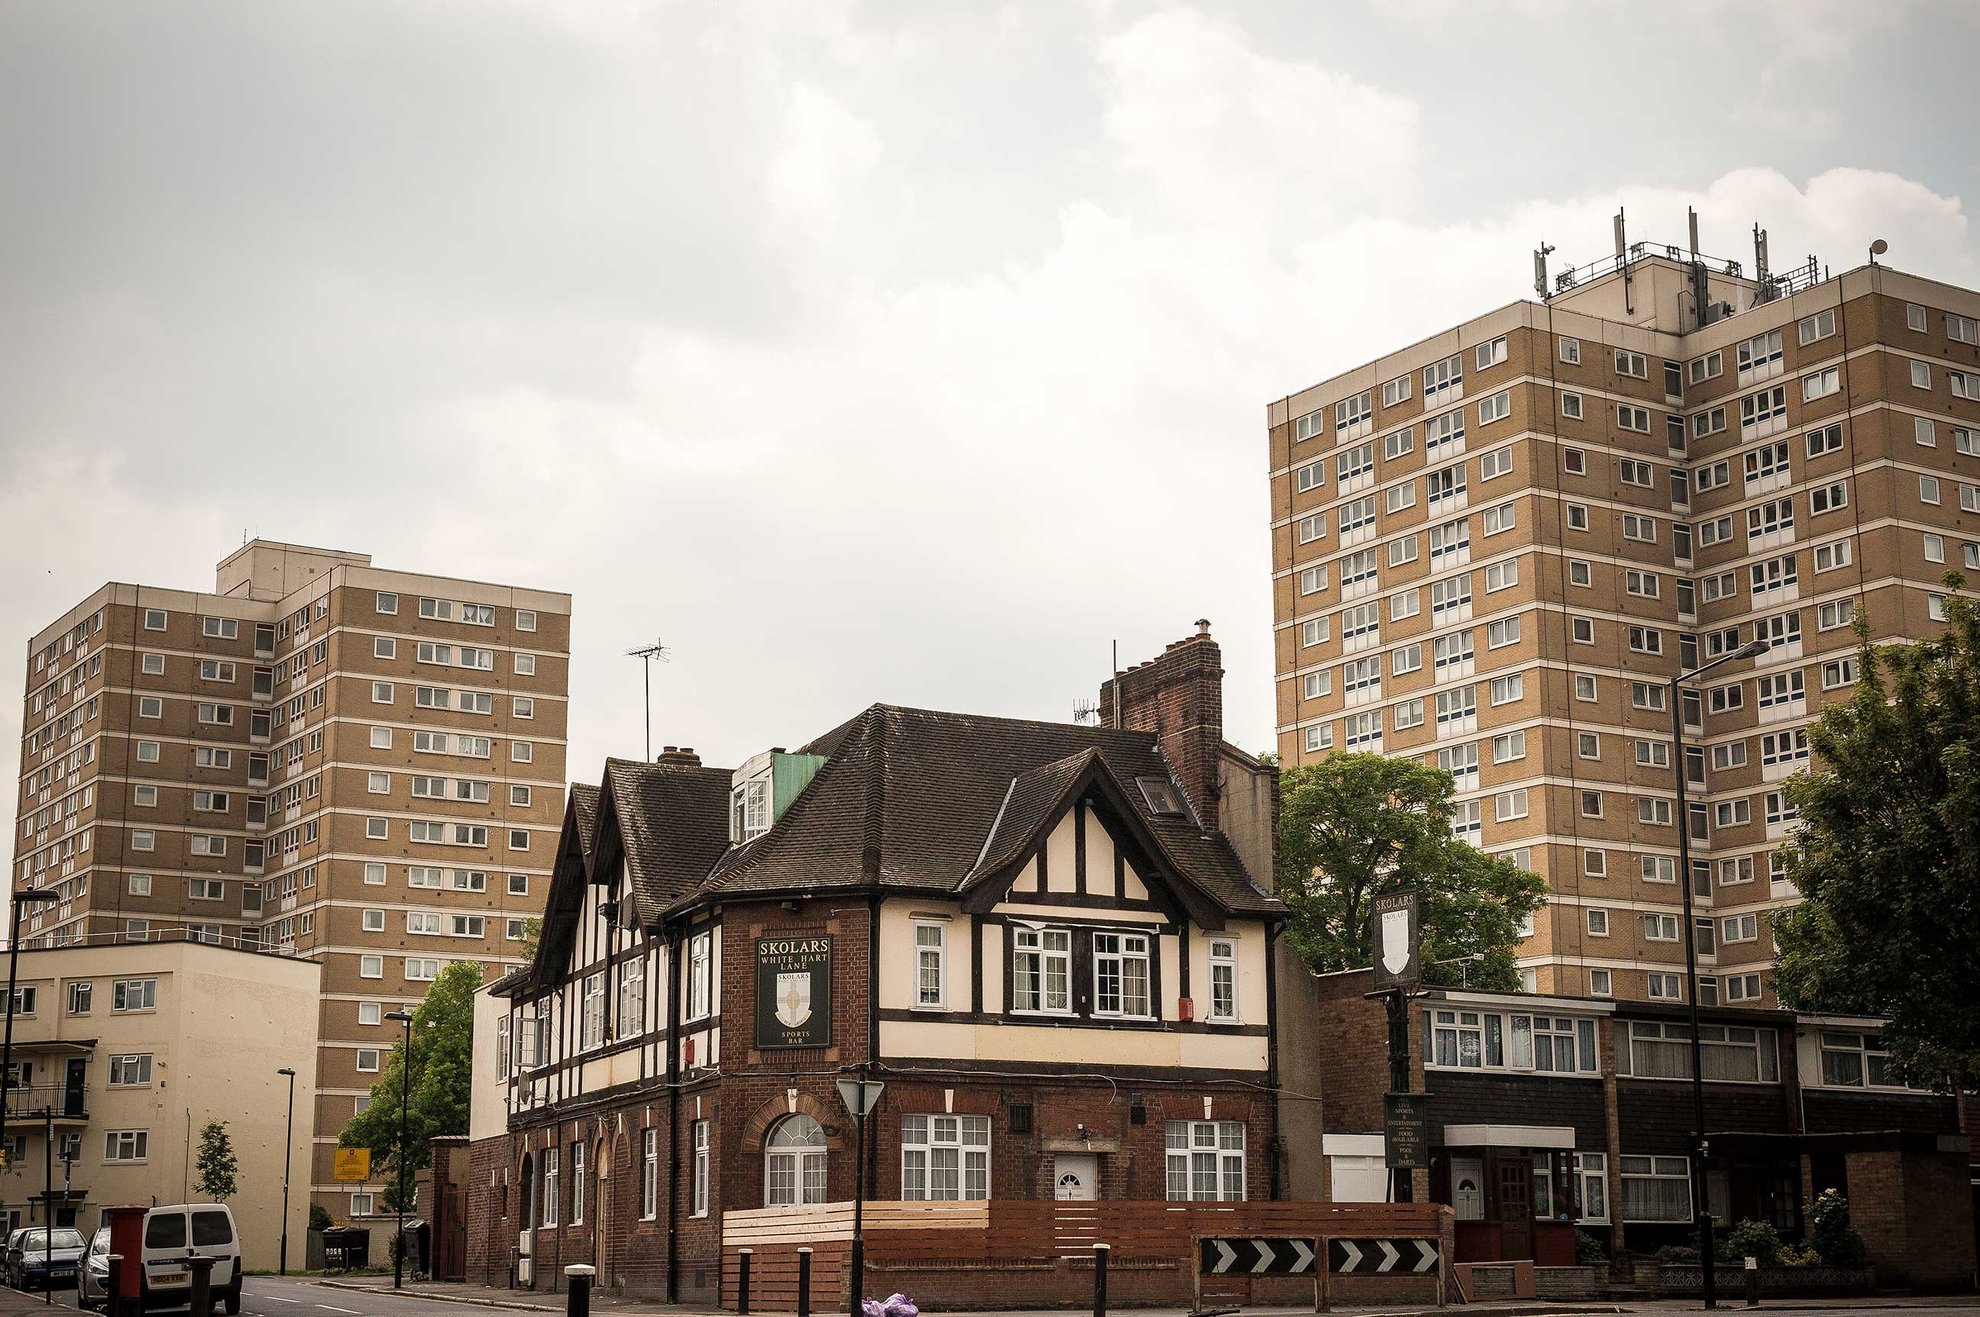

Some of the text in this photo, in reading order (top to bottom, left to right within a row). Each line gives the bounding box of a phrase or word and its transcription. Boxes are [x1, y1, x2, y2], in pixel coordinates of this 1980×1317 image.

[1376, 895, 1414, 910] SKOLARS
[1384, 911, 1406, 920] SKOLARS
[761, 940, 828, 954] SKOLARS
[761, 953, 828, 964] WHITE HART
